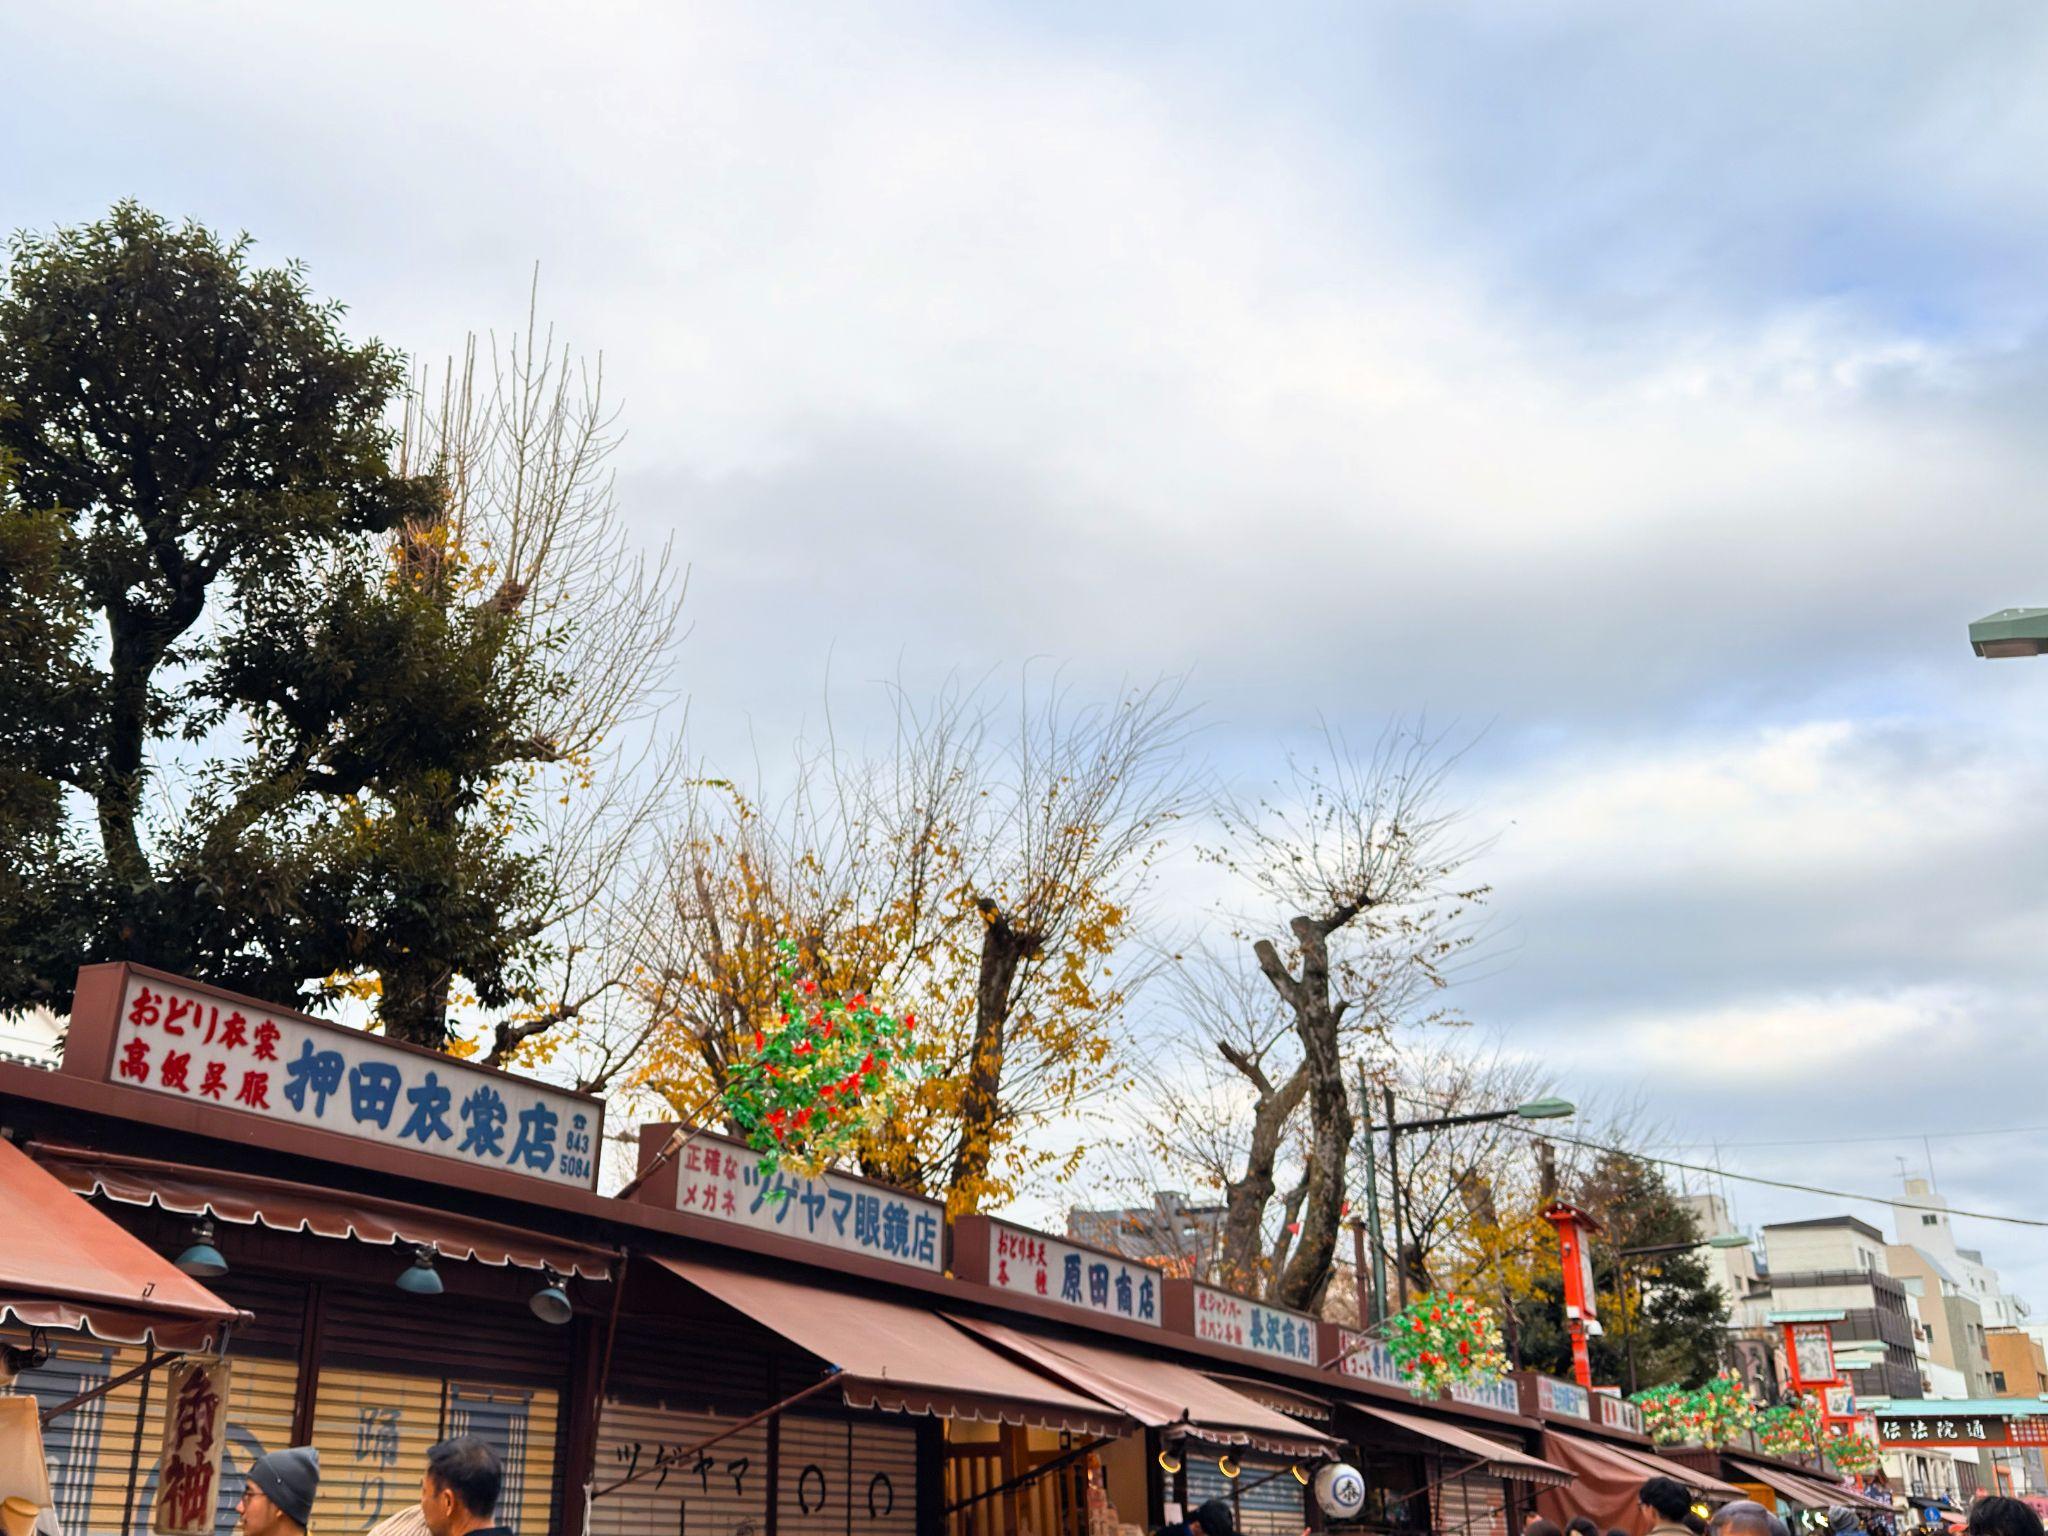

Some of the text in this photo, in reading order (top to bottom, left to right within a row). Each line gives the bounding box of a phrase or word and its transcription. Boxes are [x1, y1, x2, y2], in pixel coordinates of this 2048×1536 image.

[129, 987, 281, 1061] おどり衣裳
[119, 1037, 270, 1110] 高級呉服
[283, 1038, 559, 1173] 押田衣裳店
[560, 1154, 590, 1180] 5084
[566, 1131, 590, 1154] 843
[684, 1144, 738, 1181] 正確な
[683, 1184, 737, 1217] メガネ
[743, 1165, 938, 1265] ツゲヤマ眼鏡店
[1061, 1253, 1155, 1320] 原田商店
[1250, 1308, 1311, 1360] 長沢商店
[1882, 1419, 1987, 1440] 伝法院通
